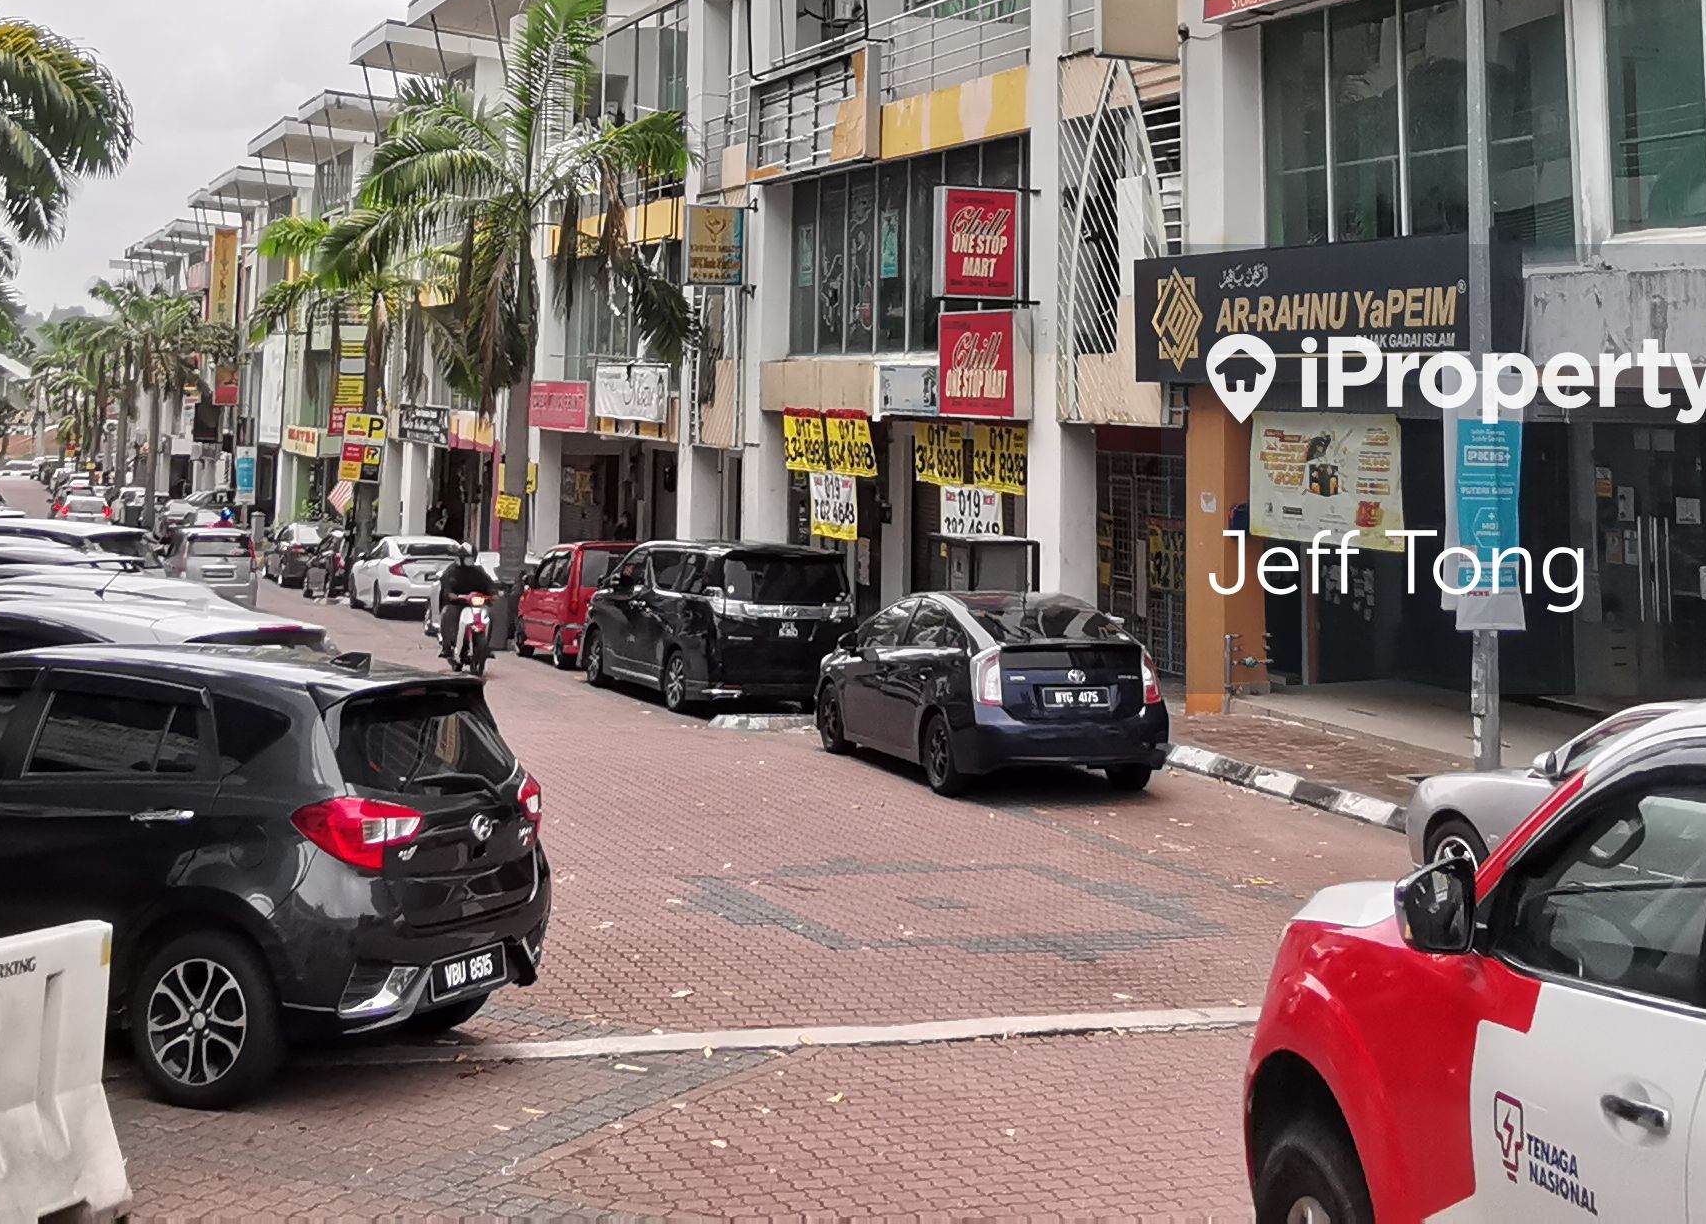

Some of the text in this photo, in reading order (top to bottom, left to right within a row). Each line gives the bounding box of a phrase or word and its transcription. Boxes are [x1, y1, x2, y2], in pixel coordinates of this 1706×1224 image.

[950, 205, 1011, 236] Chill
[952, 233, 1008, 256] ONE STOP
[961, 257, 997, 278] MART
[1215, 285, 1457, 334] AR-RAHNU YaPEIM
[952, 331, 1003, 371] Chill
[1389, 333, 1421, 348] GADAI
[1423, 332, 1456, 348] ISLAM
[927, 424, 949, 448] 017
[989, 427, 1013, 452] 017
[958, 489, 981, 519] 019
[444, 952, 493, 989] VBU 8515
[1526, 1132, 1599, 1217] TENAGA NASIONAL
